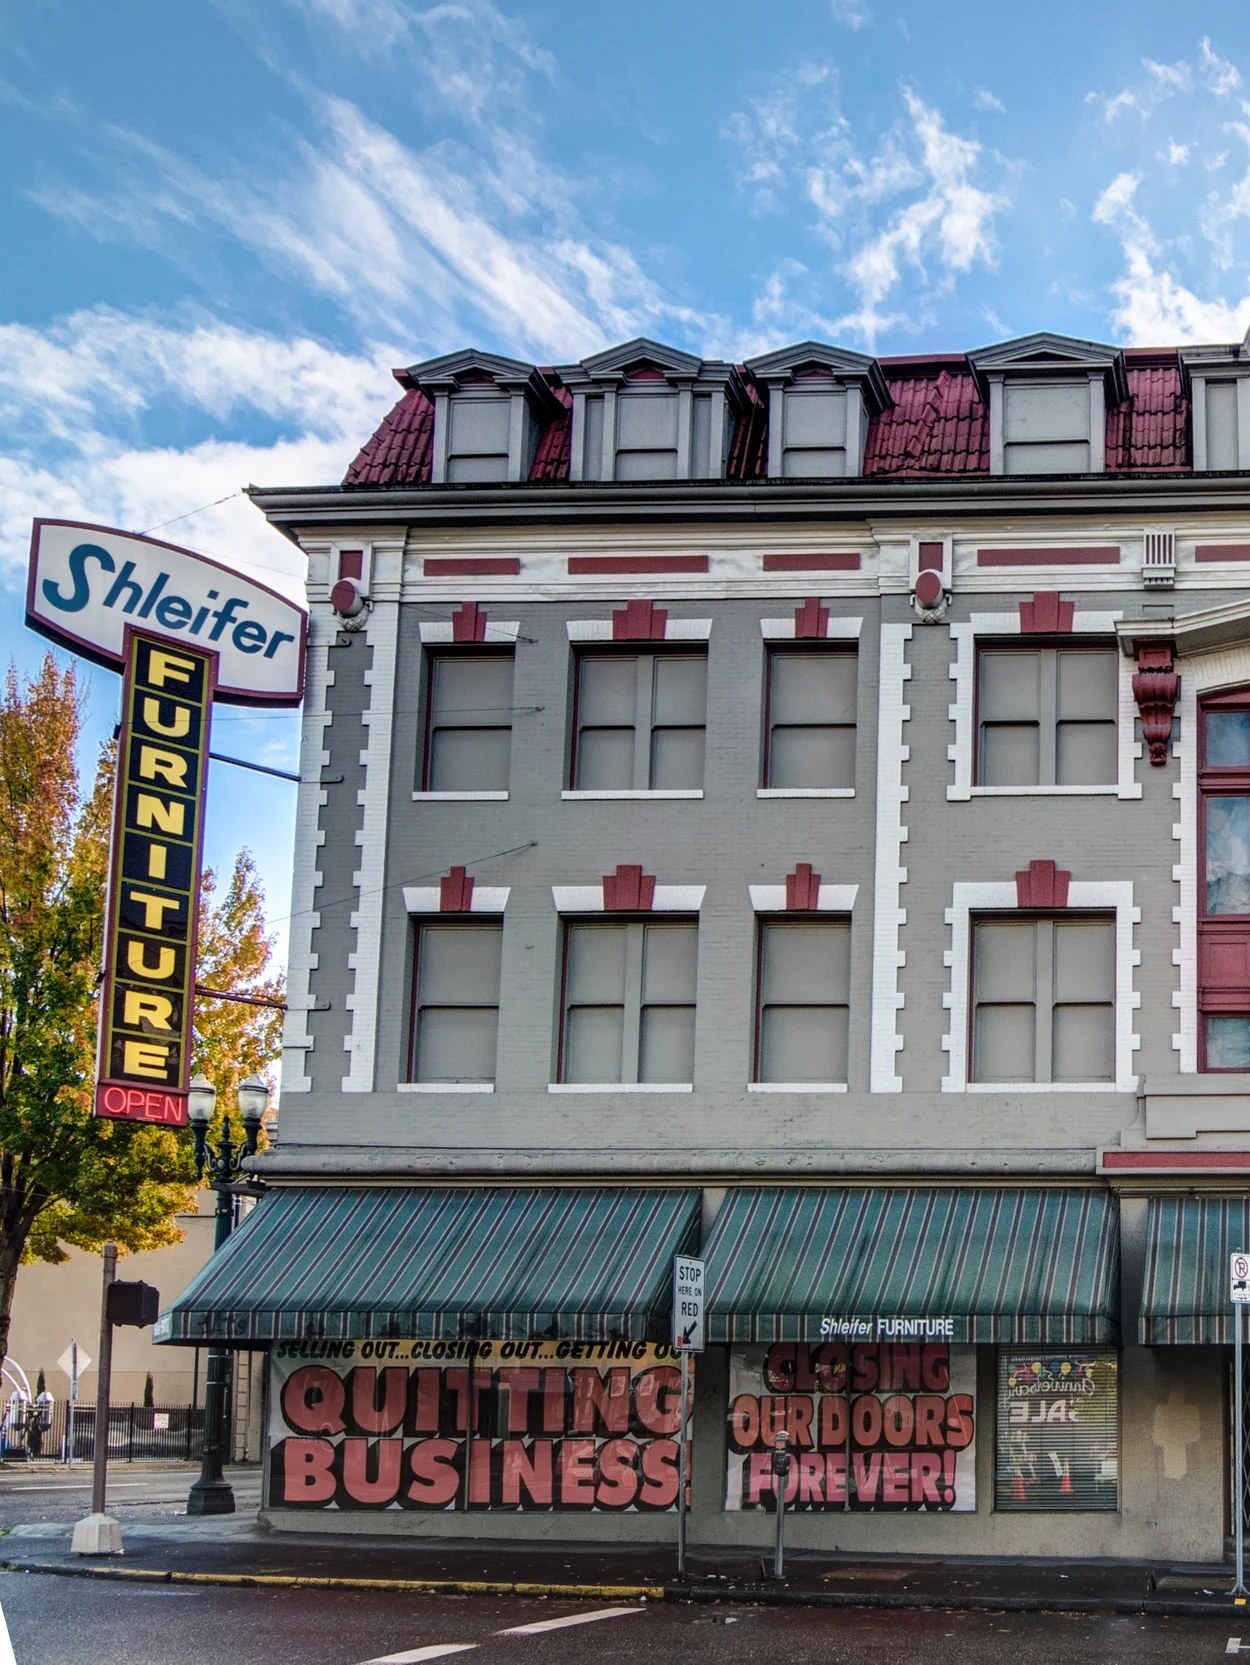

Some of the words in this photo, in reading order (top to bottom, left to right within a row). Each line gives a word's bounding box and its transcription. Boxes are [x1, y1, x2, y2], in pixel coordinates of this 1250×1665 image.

[42, 543, 295, 659] Shleifer
[123, 649, 196, 1079] FURNITURE
[104, 1087, 183, 1122] OPEN
[677, 1285, 692, 1296] HERE
[694, 1287, 702, 1297] ON
[679, 1265, 701, 1282] STOP
[681, 1301, 699, 1317] RED
[820, 1317, 873, 1335] Shleifer
[877, 1319, 953, 1336] FURNITURE
[277, 1340, 355, 1360] SELLING
[764, 1343, 950, 1393] CLOSING
[281, 1365, 694, 1439] QUITTING
[729, 1394, 815, 1453] OUR
[818, 1394, 974, 1452] DOORS
[742, 1449, 957, 1510] FOREVER!
